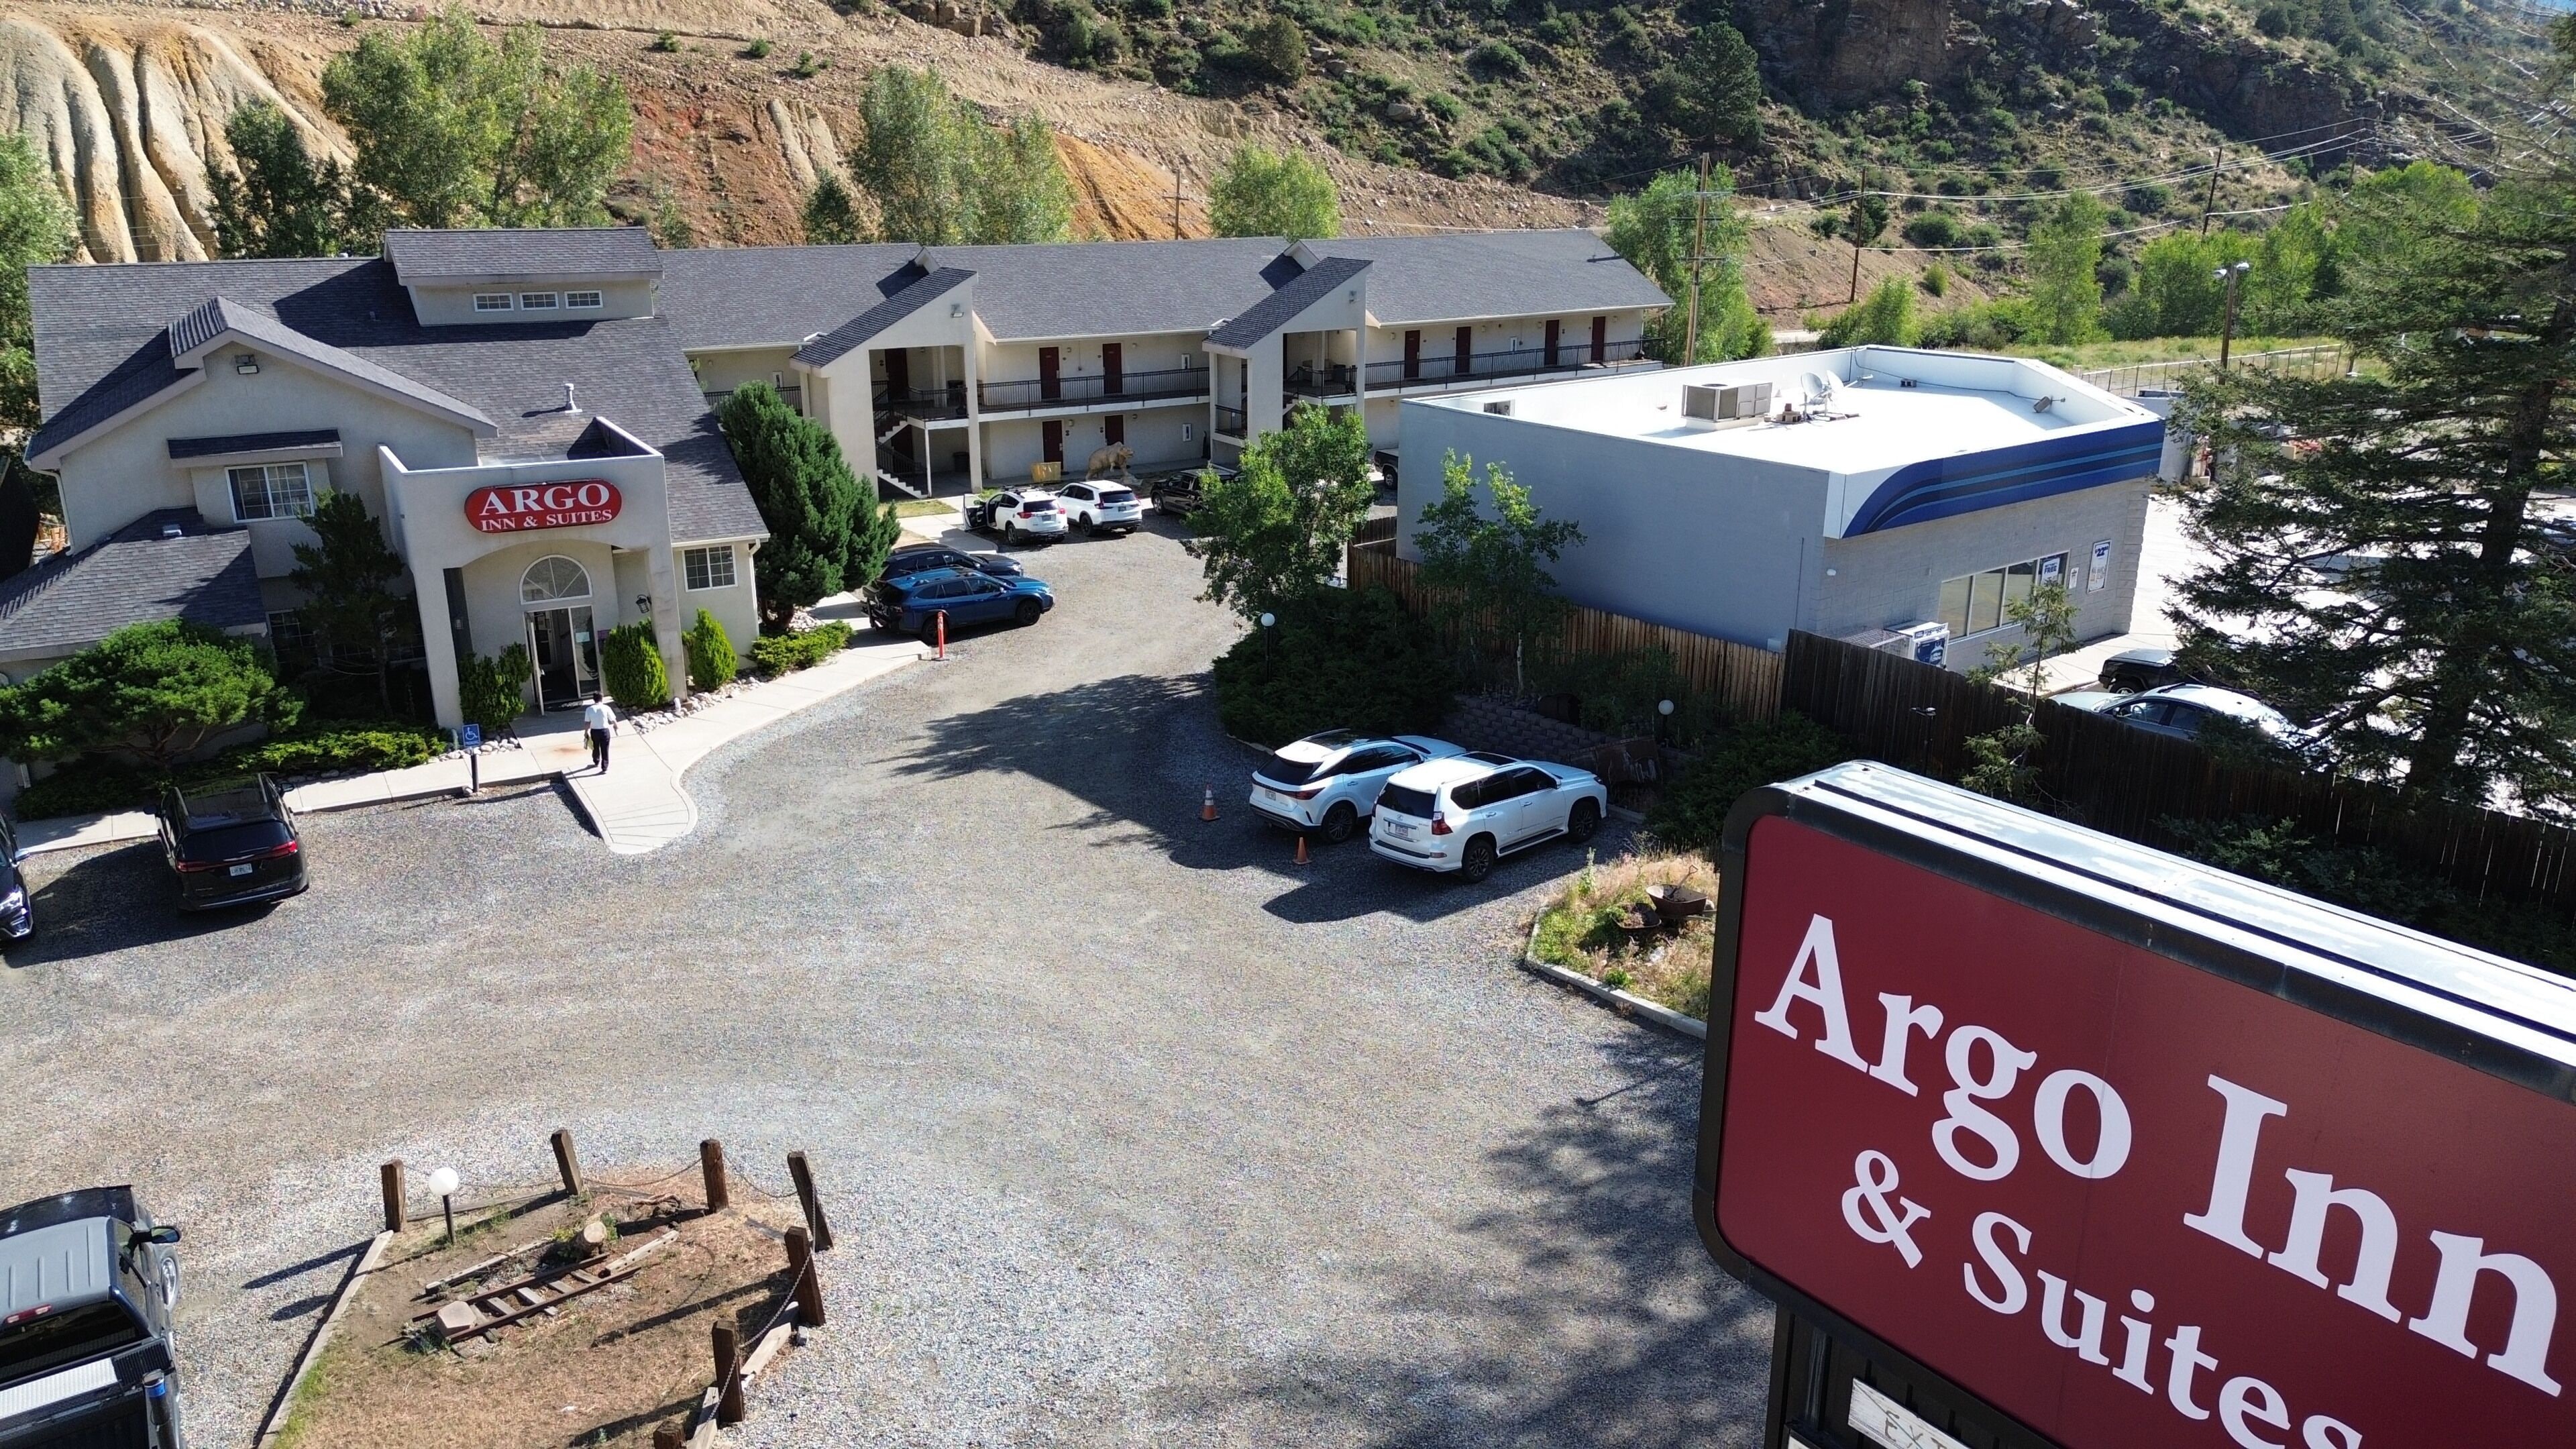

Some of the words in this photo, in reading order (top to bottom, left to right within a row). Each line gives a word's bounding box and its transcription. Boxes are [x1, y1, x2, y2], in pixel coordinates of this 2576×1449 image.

[479, 483, 610, 516] ARGO
[480, 517, 516, 531] INN
[523, 516, 537, 527] &
[546, 509, 612, 526] SUITES
[1754, 913, 2132, 1181] Argo
[2183, 1073, 2562, 1397] Inn
[1841, 1150, 1931, 1269] &
